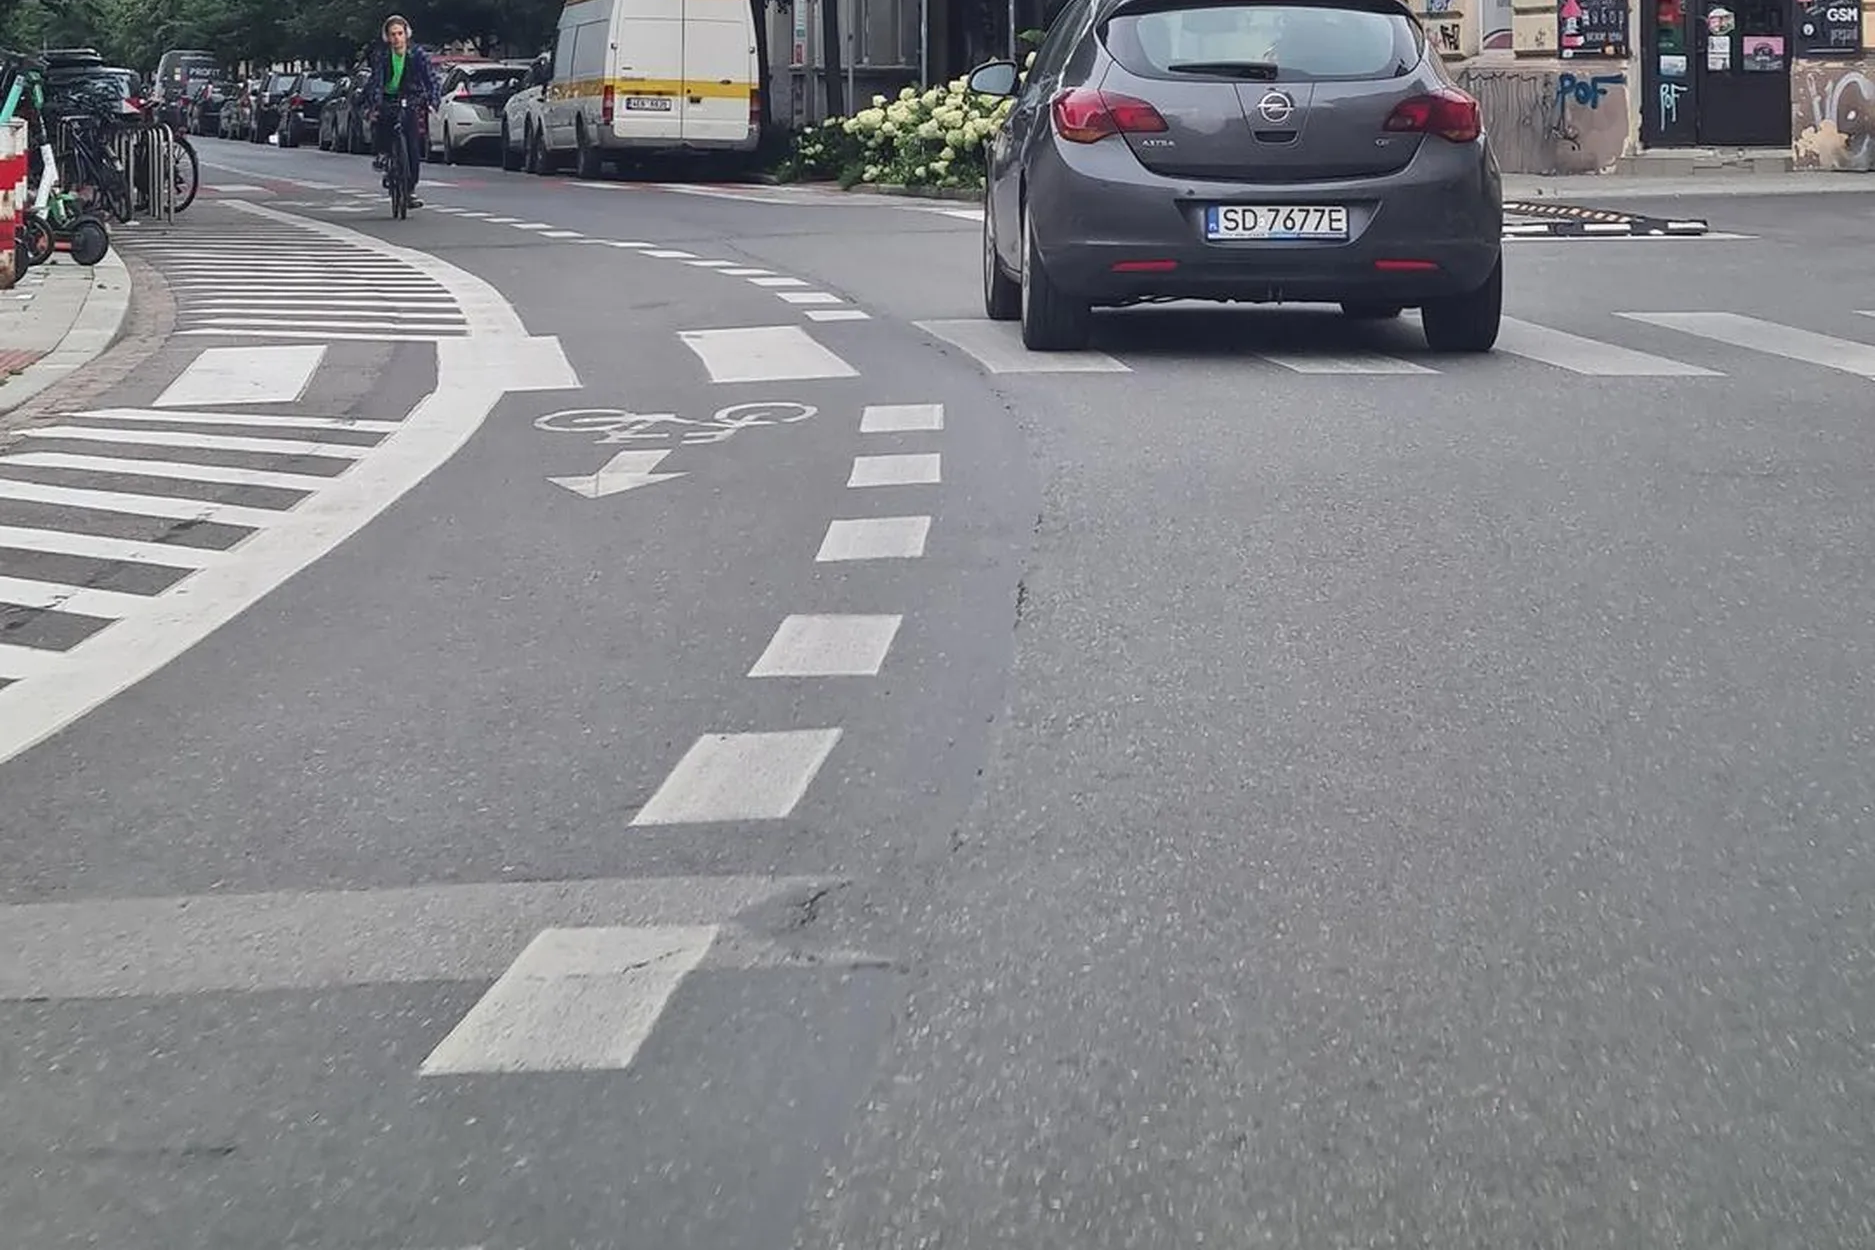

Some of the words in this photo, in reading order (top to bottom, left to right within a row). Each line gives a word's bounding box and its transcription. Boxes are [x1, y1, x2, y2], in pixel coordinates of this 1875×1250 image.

[1826, 7, 1858, 21] GSM
[1223, 208, 1258, 232] SD
[1267, 208, 1344, 232] 7677E
